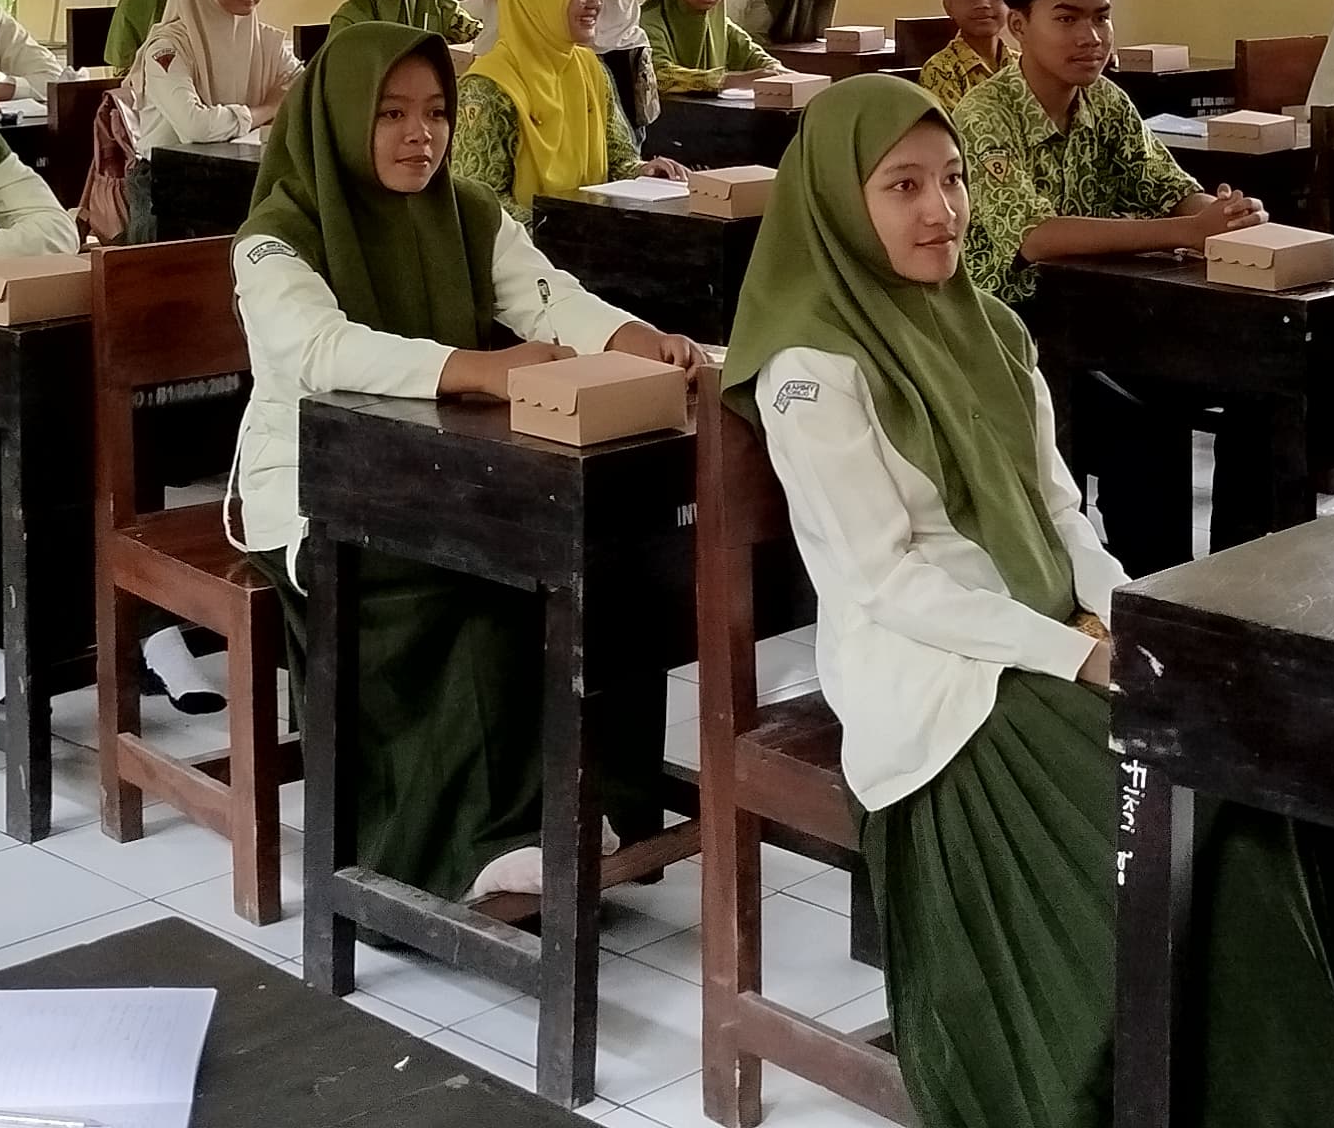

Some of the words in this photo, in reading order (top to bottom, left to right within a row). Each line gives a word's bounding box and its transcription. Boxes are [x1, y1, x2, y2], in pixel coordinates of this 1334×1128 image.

[469, 107, 476, 120] 8
[992, 161, 1004, 175] 8
[1120, 759, 1147, 834] Fikri
